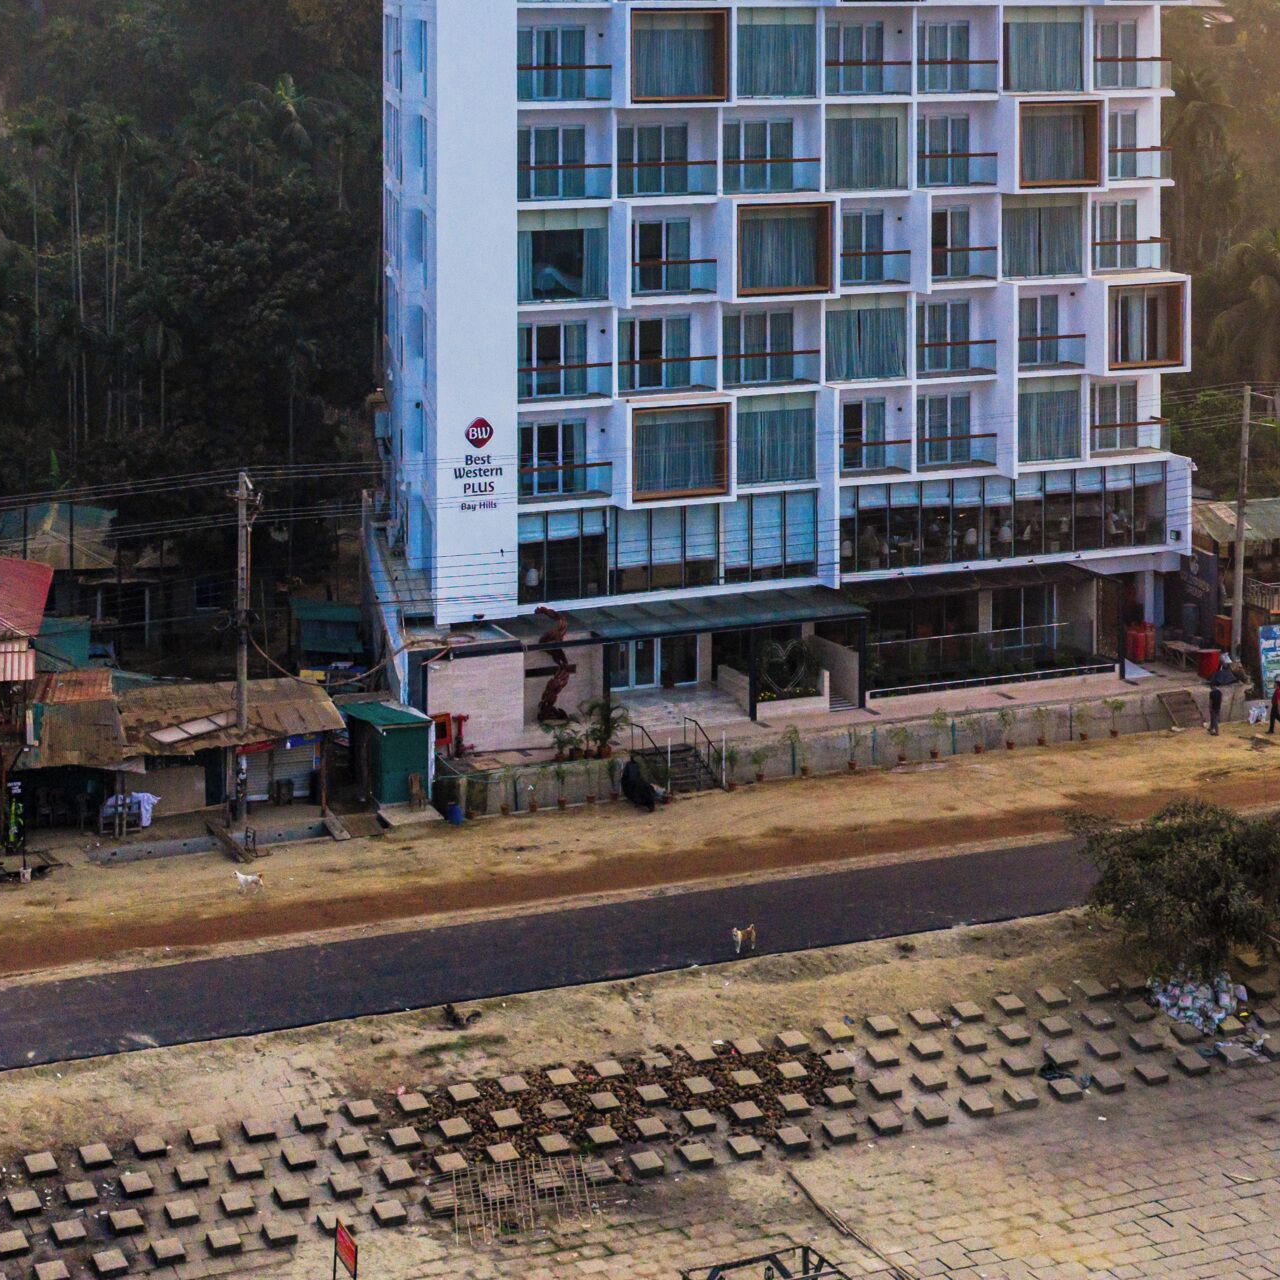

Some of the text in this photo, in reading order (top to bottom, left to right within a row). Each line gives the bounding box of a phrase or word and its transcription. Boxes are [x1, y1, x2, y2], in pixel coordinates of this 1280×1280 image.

[469, 427, 490, 439] BW
[465, 454, 491, 465] Best
[454, 467, 502, 479] Western
[464, 481, 494, 493] PLUS
[461, 501, 497, 511] Bay Hills
